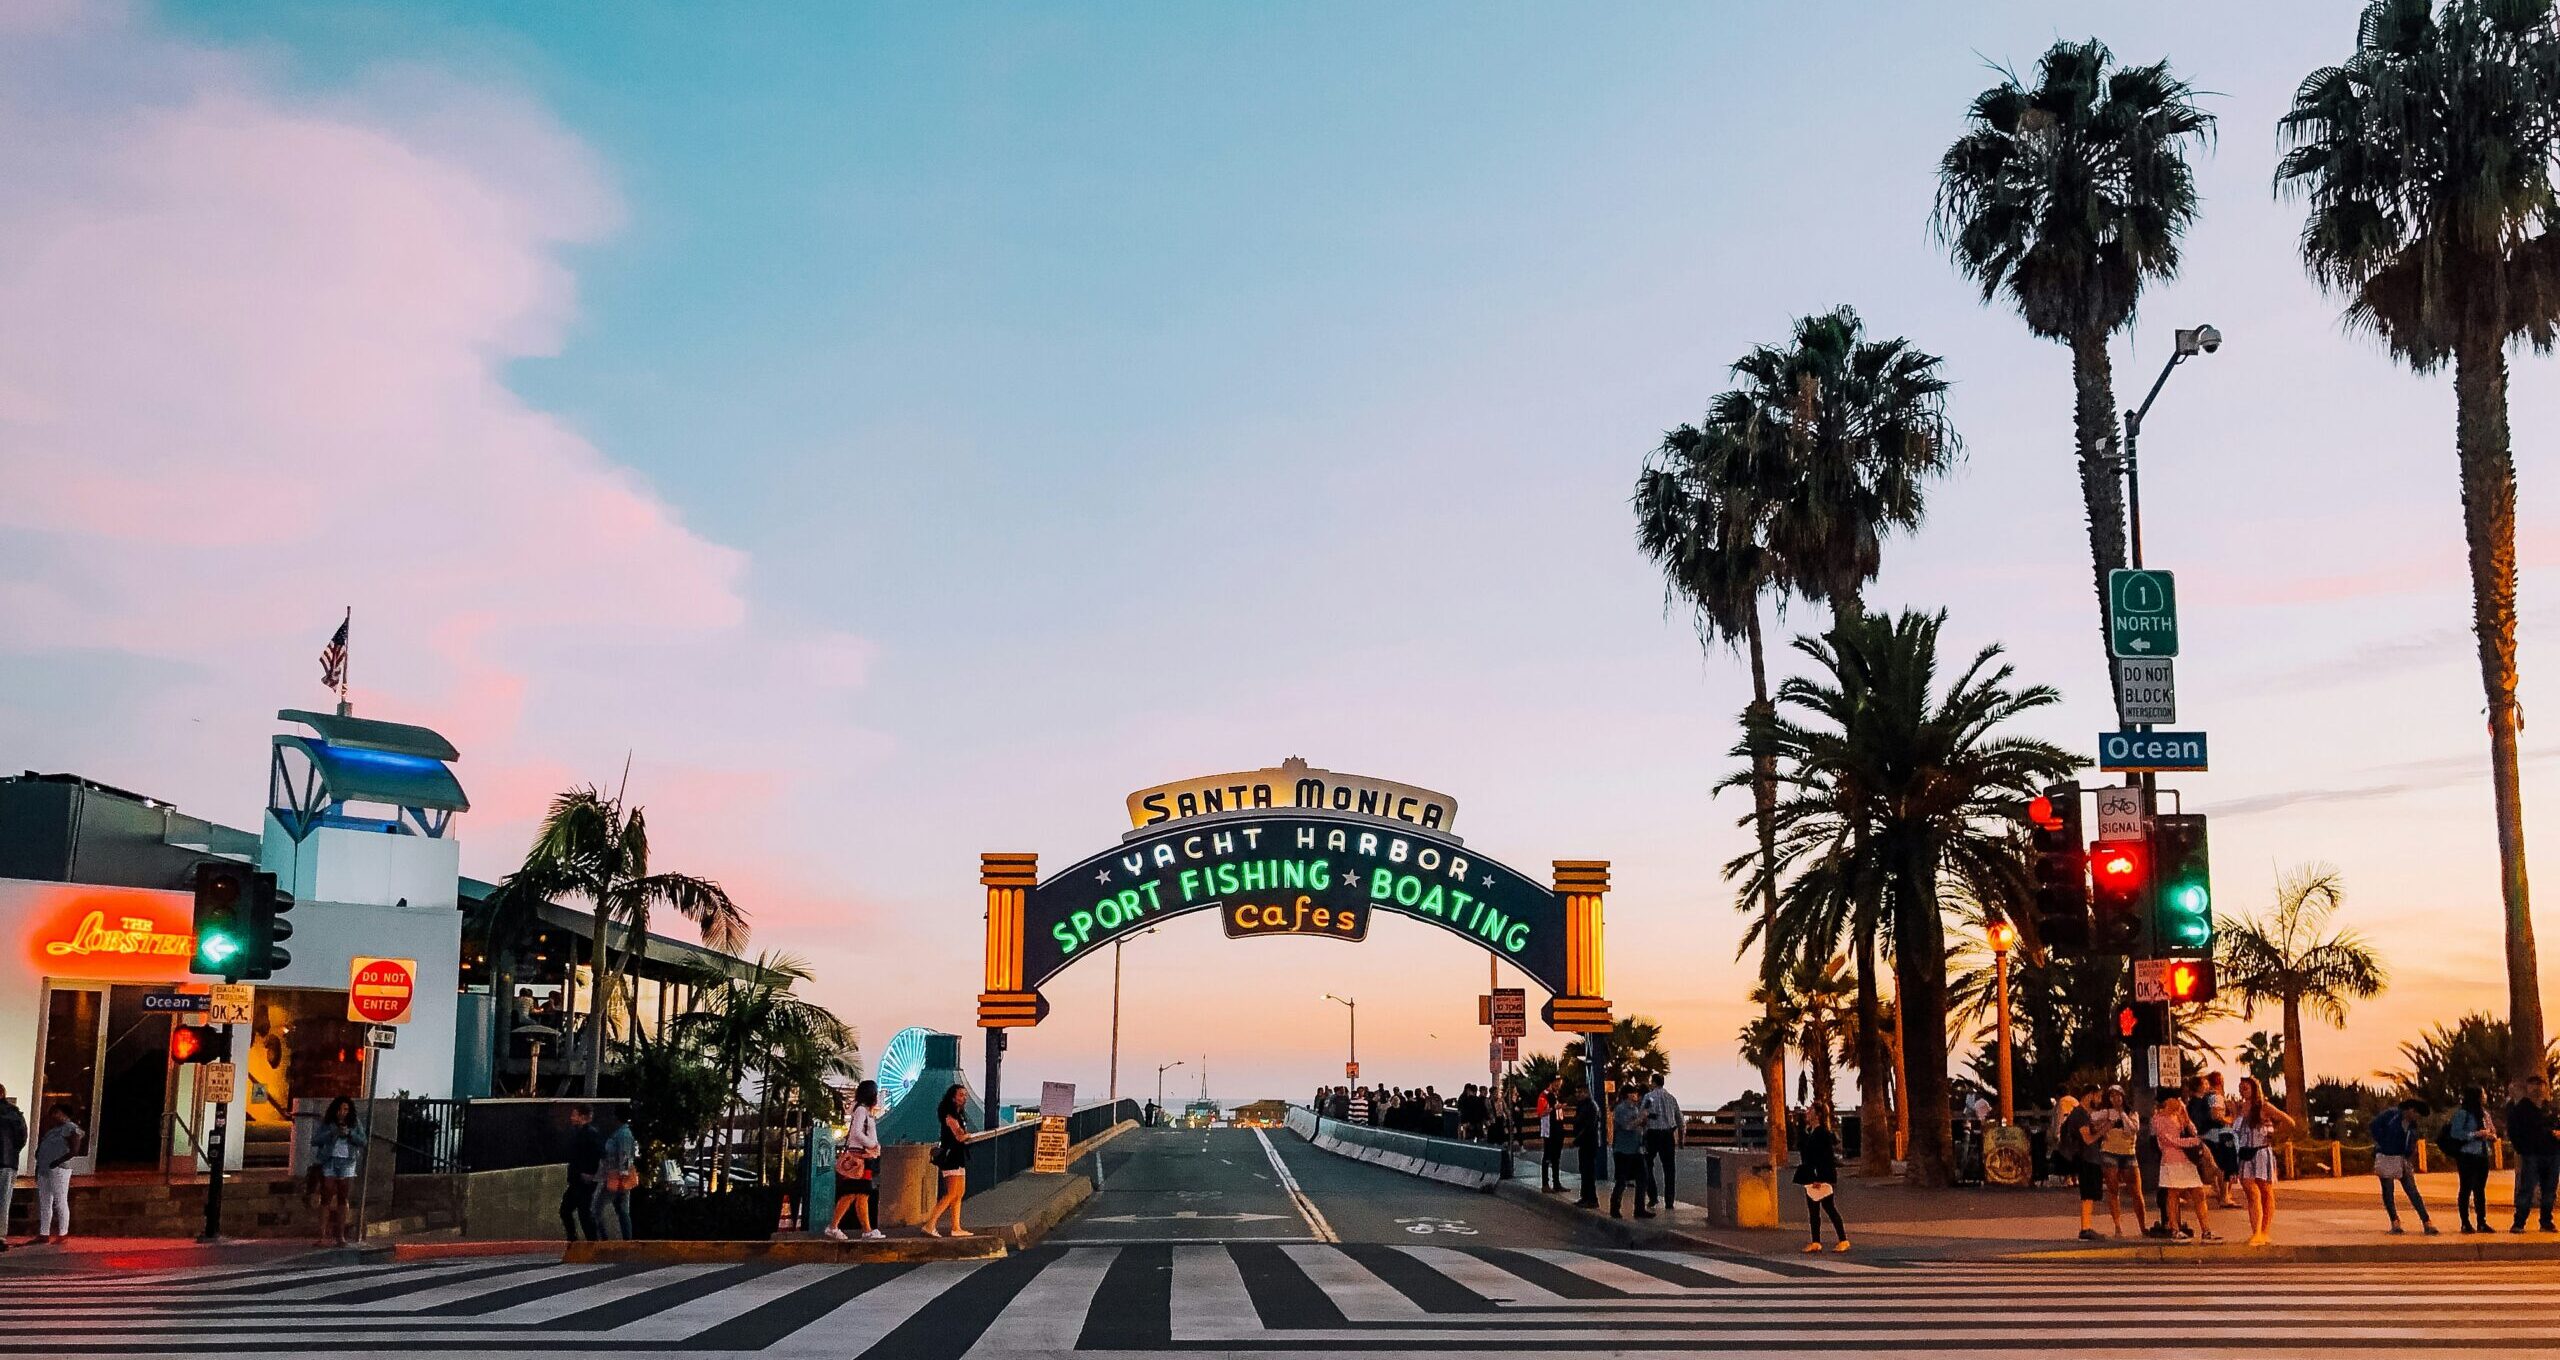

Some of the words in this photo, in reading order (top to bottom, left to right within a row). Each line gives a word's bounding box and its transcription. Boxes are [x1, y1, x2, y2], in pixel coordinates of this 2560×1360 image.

[2139, 586, 2147, 605] 1
[2116, 616, 2172, 631] NORTH
[2124, 667, 2142, 682] DO
[2145, 667, 2169, 682] NOT
[2125, 688, 2172, 703] BLOCK
[2125, 707, 2172, 718] INTERSECTION
[2107, 737, 2199, 760] Ocean
[1143, 785, 1272, 827] SANTA
[1295, 778, 1443, 829] MONICA
[2101, 820, 2139, 833] SIGNAL
[1122, 828, 1262, 877] YACHT
[1296, 827, 1469, 883] HARBOR
[1052, 879, 1162, 954] SPORT
[1180, 859, 1331, 902] FISHING
[1234, 895, 1356, 932] cafes
[1370, 868, 1531, 953] BOATING
[120, 917, 154, 931] THE
[362, 972, 378, 983] DO
[383, 973, 406, 984] NOT
[2137, 982, 2150, 997] OK
[145, 996, 190, 1008] Ocean
[363, 999, 398, 1010] ENTER
[212, 1004, 228, 1020] OK
